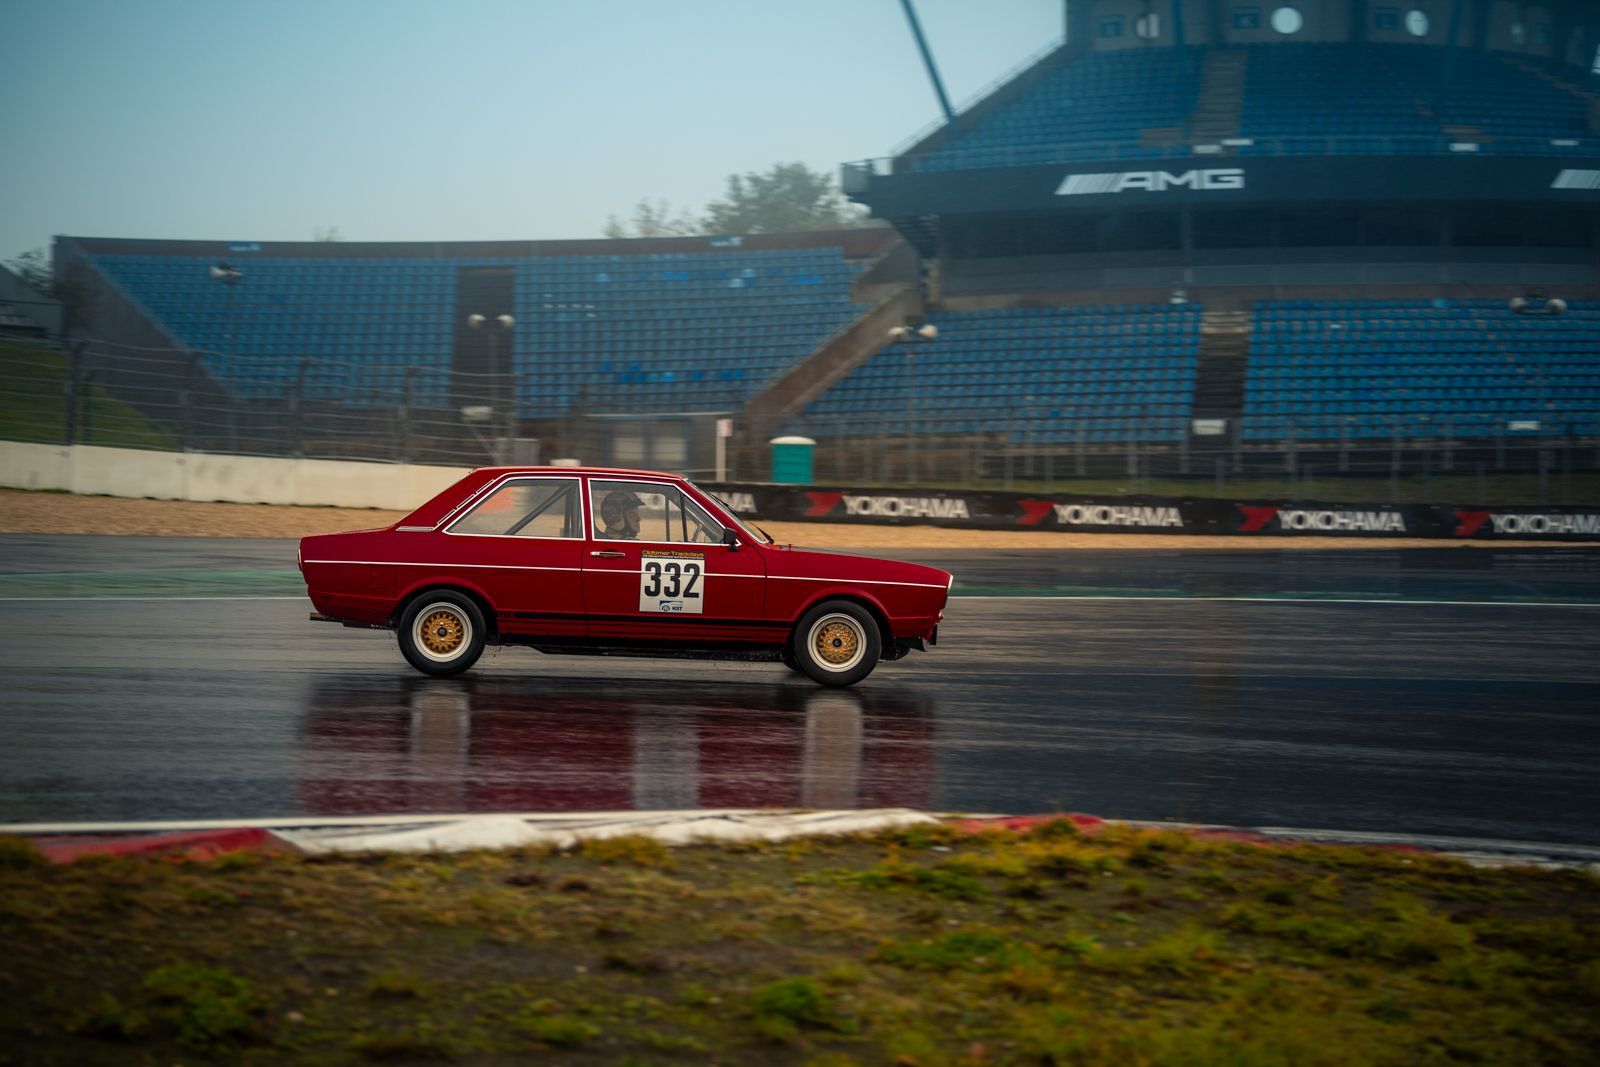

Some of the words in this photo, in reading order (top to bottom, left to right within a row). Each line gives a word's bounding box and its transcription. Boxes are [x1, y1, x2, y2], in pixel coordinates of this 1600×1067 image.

[1120, 168, 1245, 191] AMG
[842, 495, 970, 519] YOKOHAMA
[1053, 503, 1184, 527] YOKOHAMA
[1276, 510, 1407, 532] YOKOHAMA
[1489, 514, 1600, 534] YOKOHAM
[644, 561, 701, 598] 332
